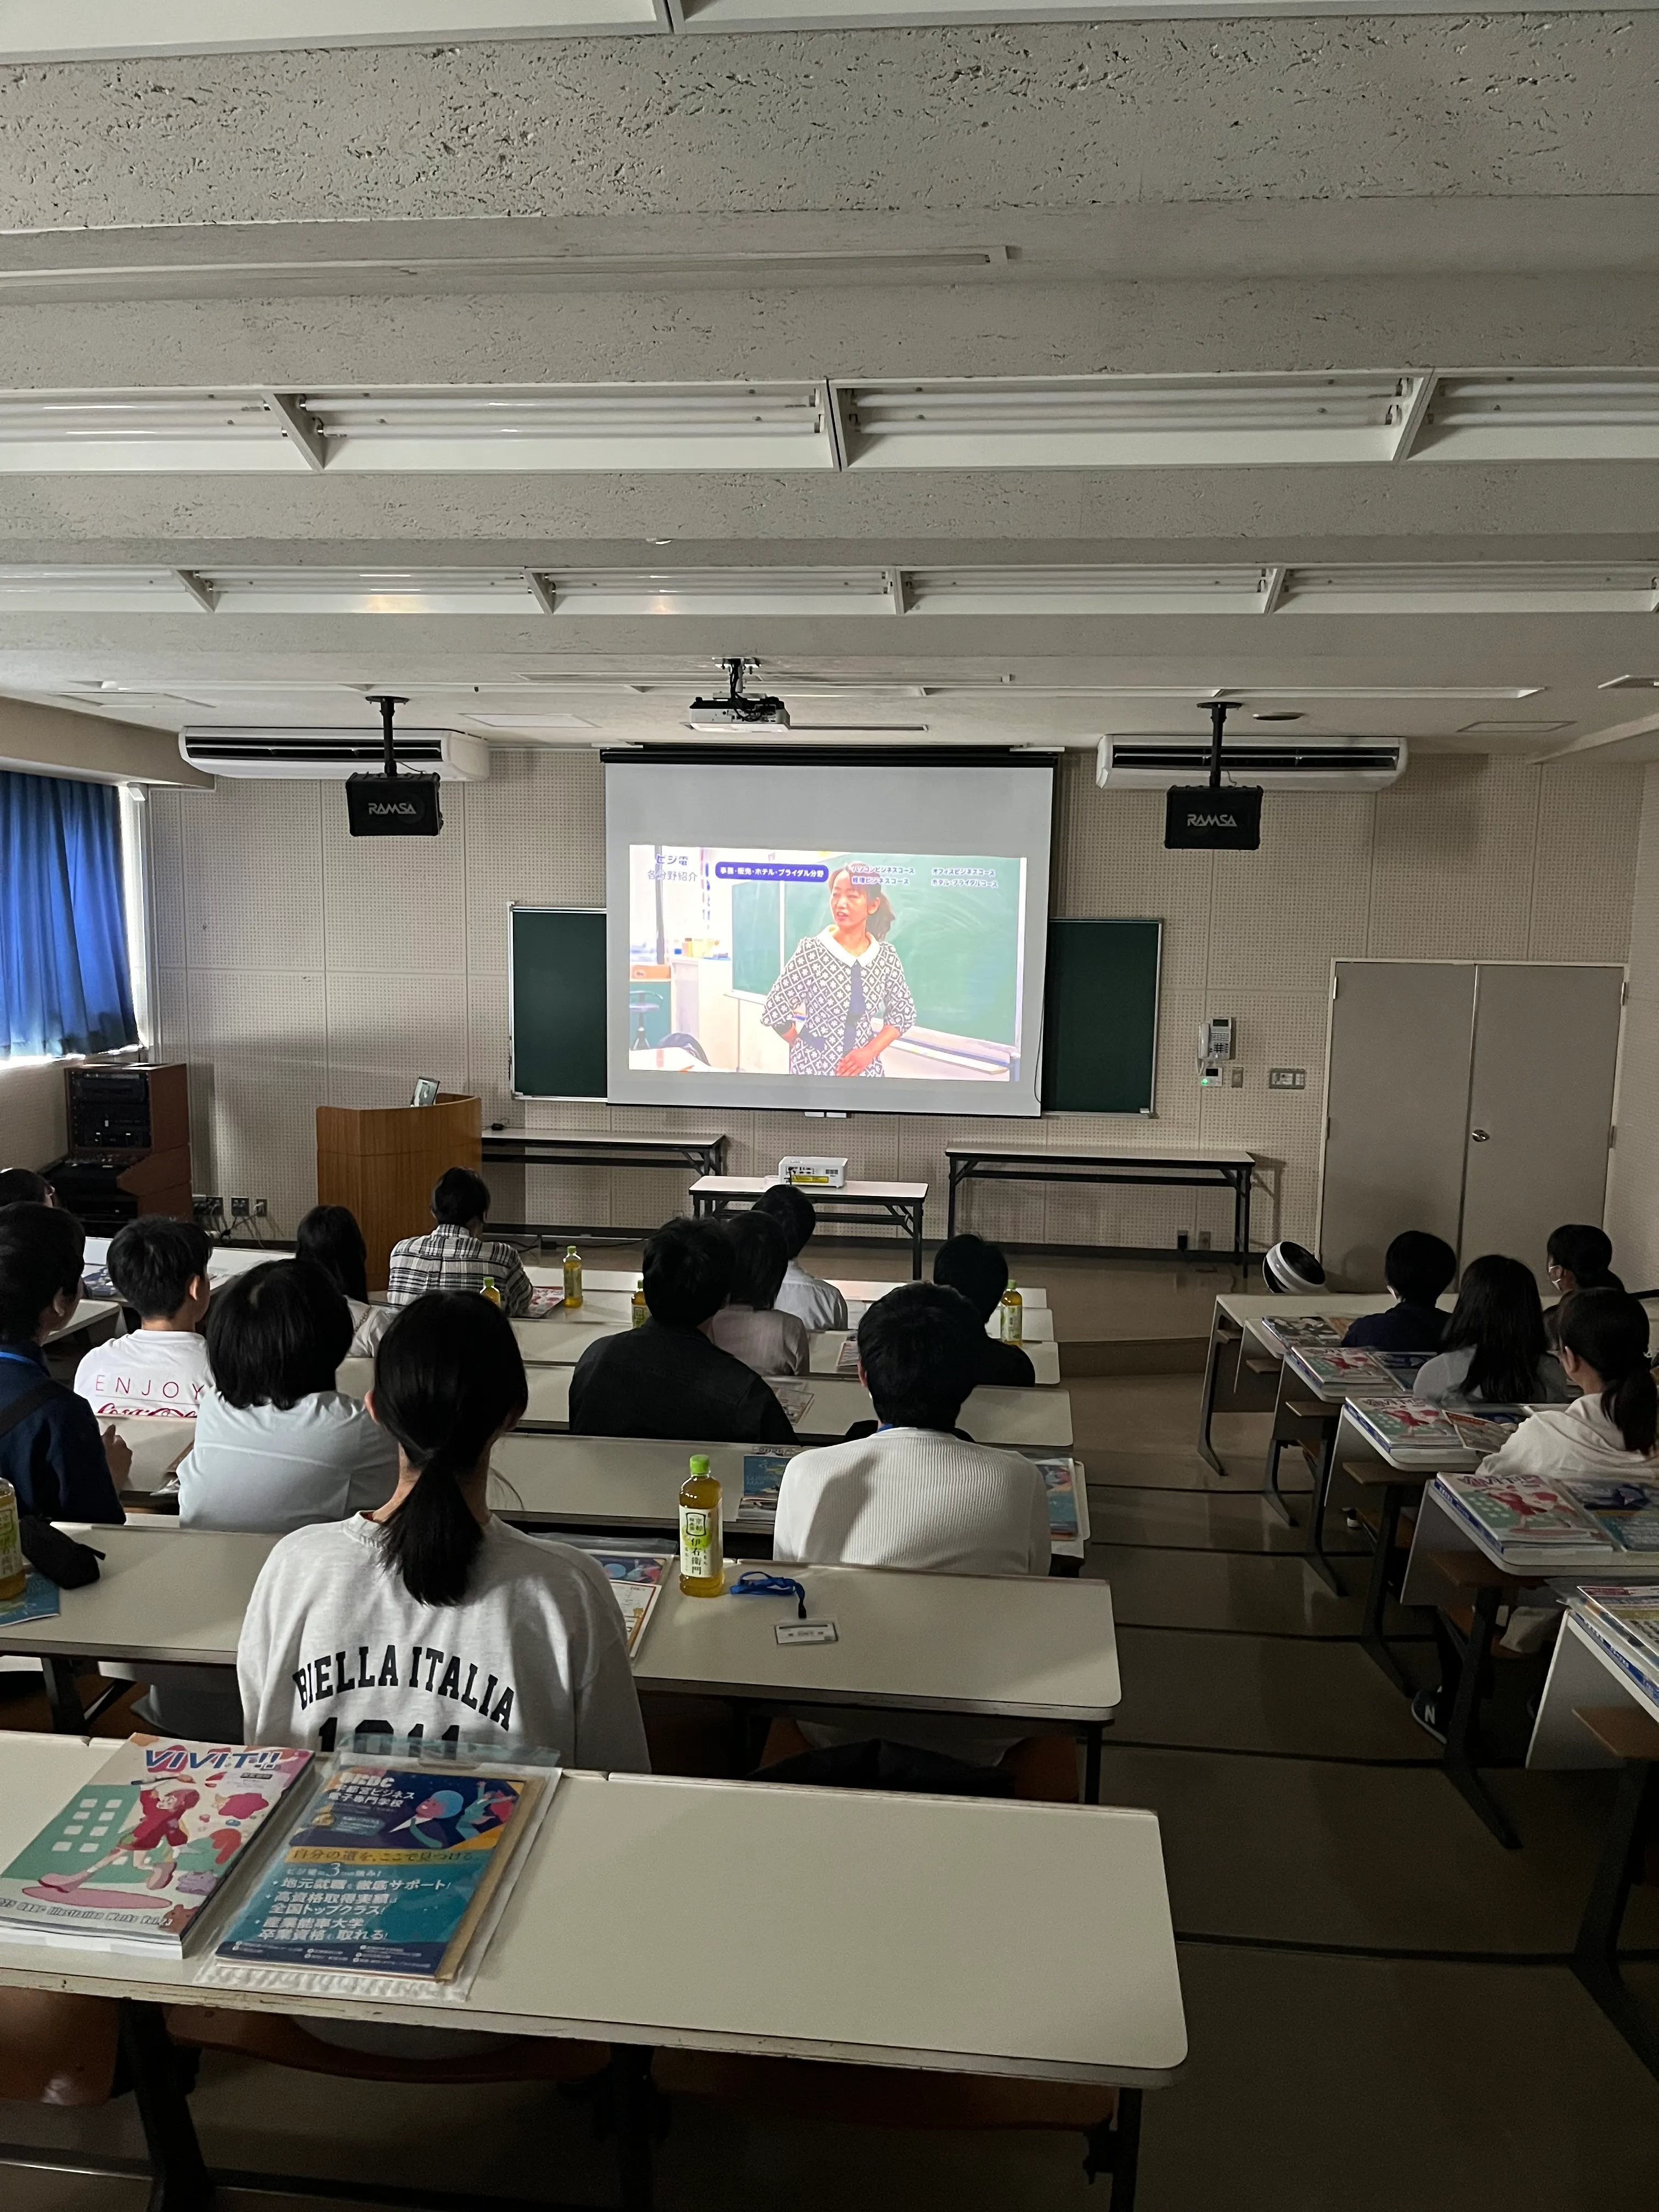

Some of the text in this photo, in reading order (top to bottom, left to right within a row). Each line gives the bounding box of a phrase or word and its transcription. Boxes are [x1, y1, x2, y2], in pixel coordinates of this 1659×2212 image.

[368, 803, 417, 815] RAMSA
[1187, 814, 1238, 827] RAMSA
[95, 1375, 205, 1400] ENJOY
[292, 1645, 515, 1732] BIELLA ITALIA
